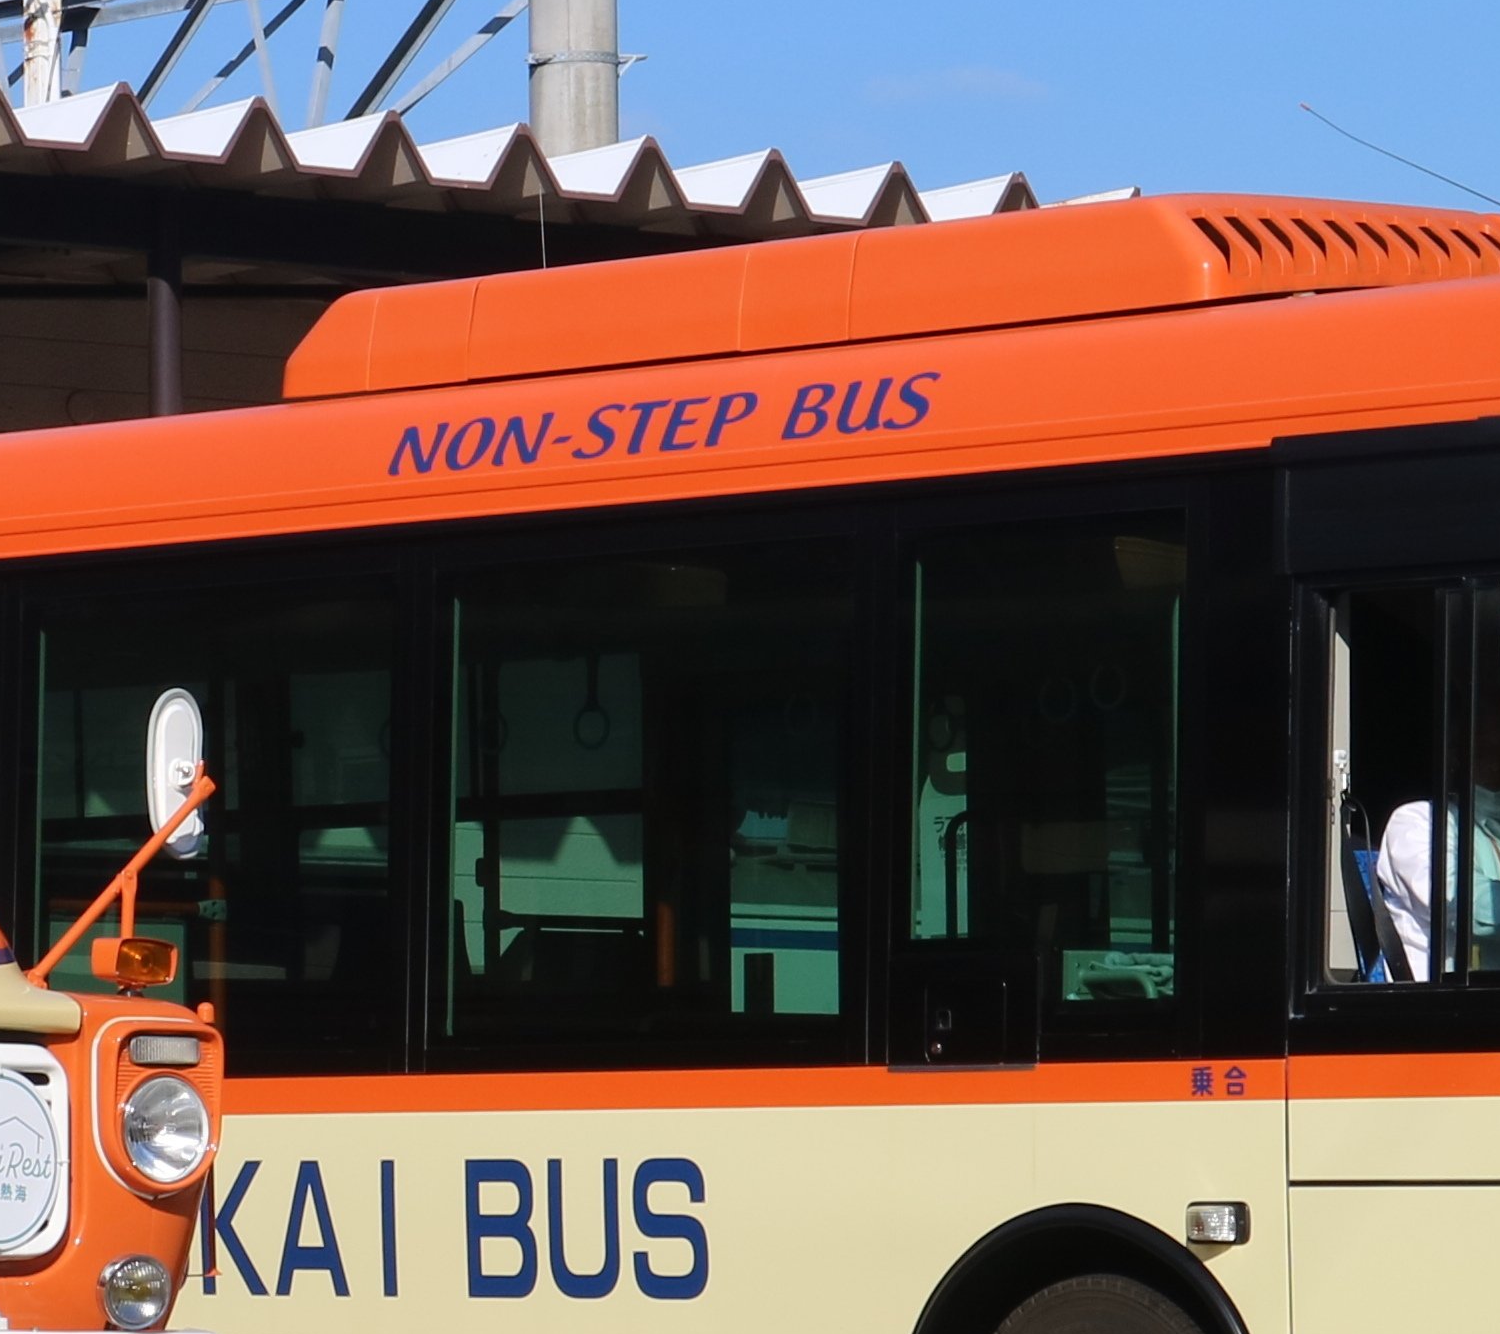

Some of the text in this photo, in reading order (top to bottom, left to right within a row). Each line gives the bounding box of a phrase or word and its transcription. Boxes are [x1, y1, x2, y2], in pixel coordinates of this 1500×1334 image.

[387, 371, 942, 476] NON-STEP BUS
[1191, 1066, 1247, 1096] 乗合
[5, 1142, 52, 1179] Rest
[465, 1158, 709, 1300] BUS
